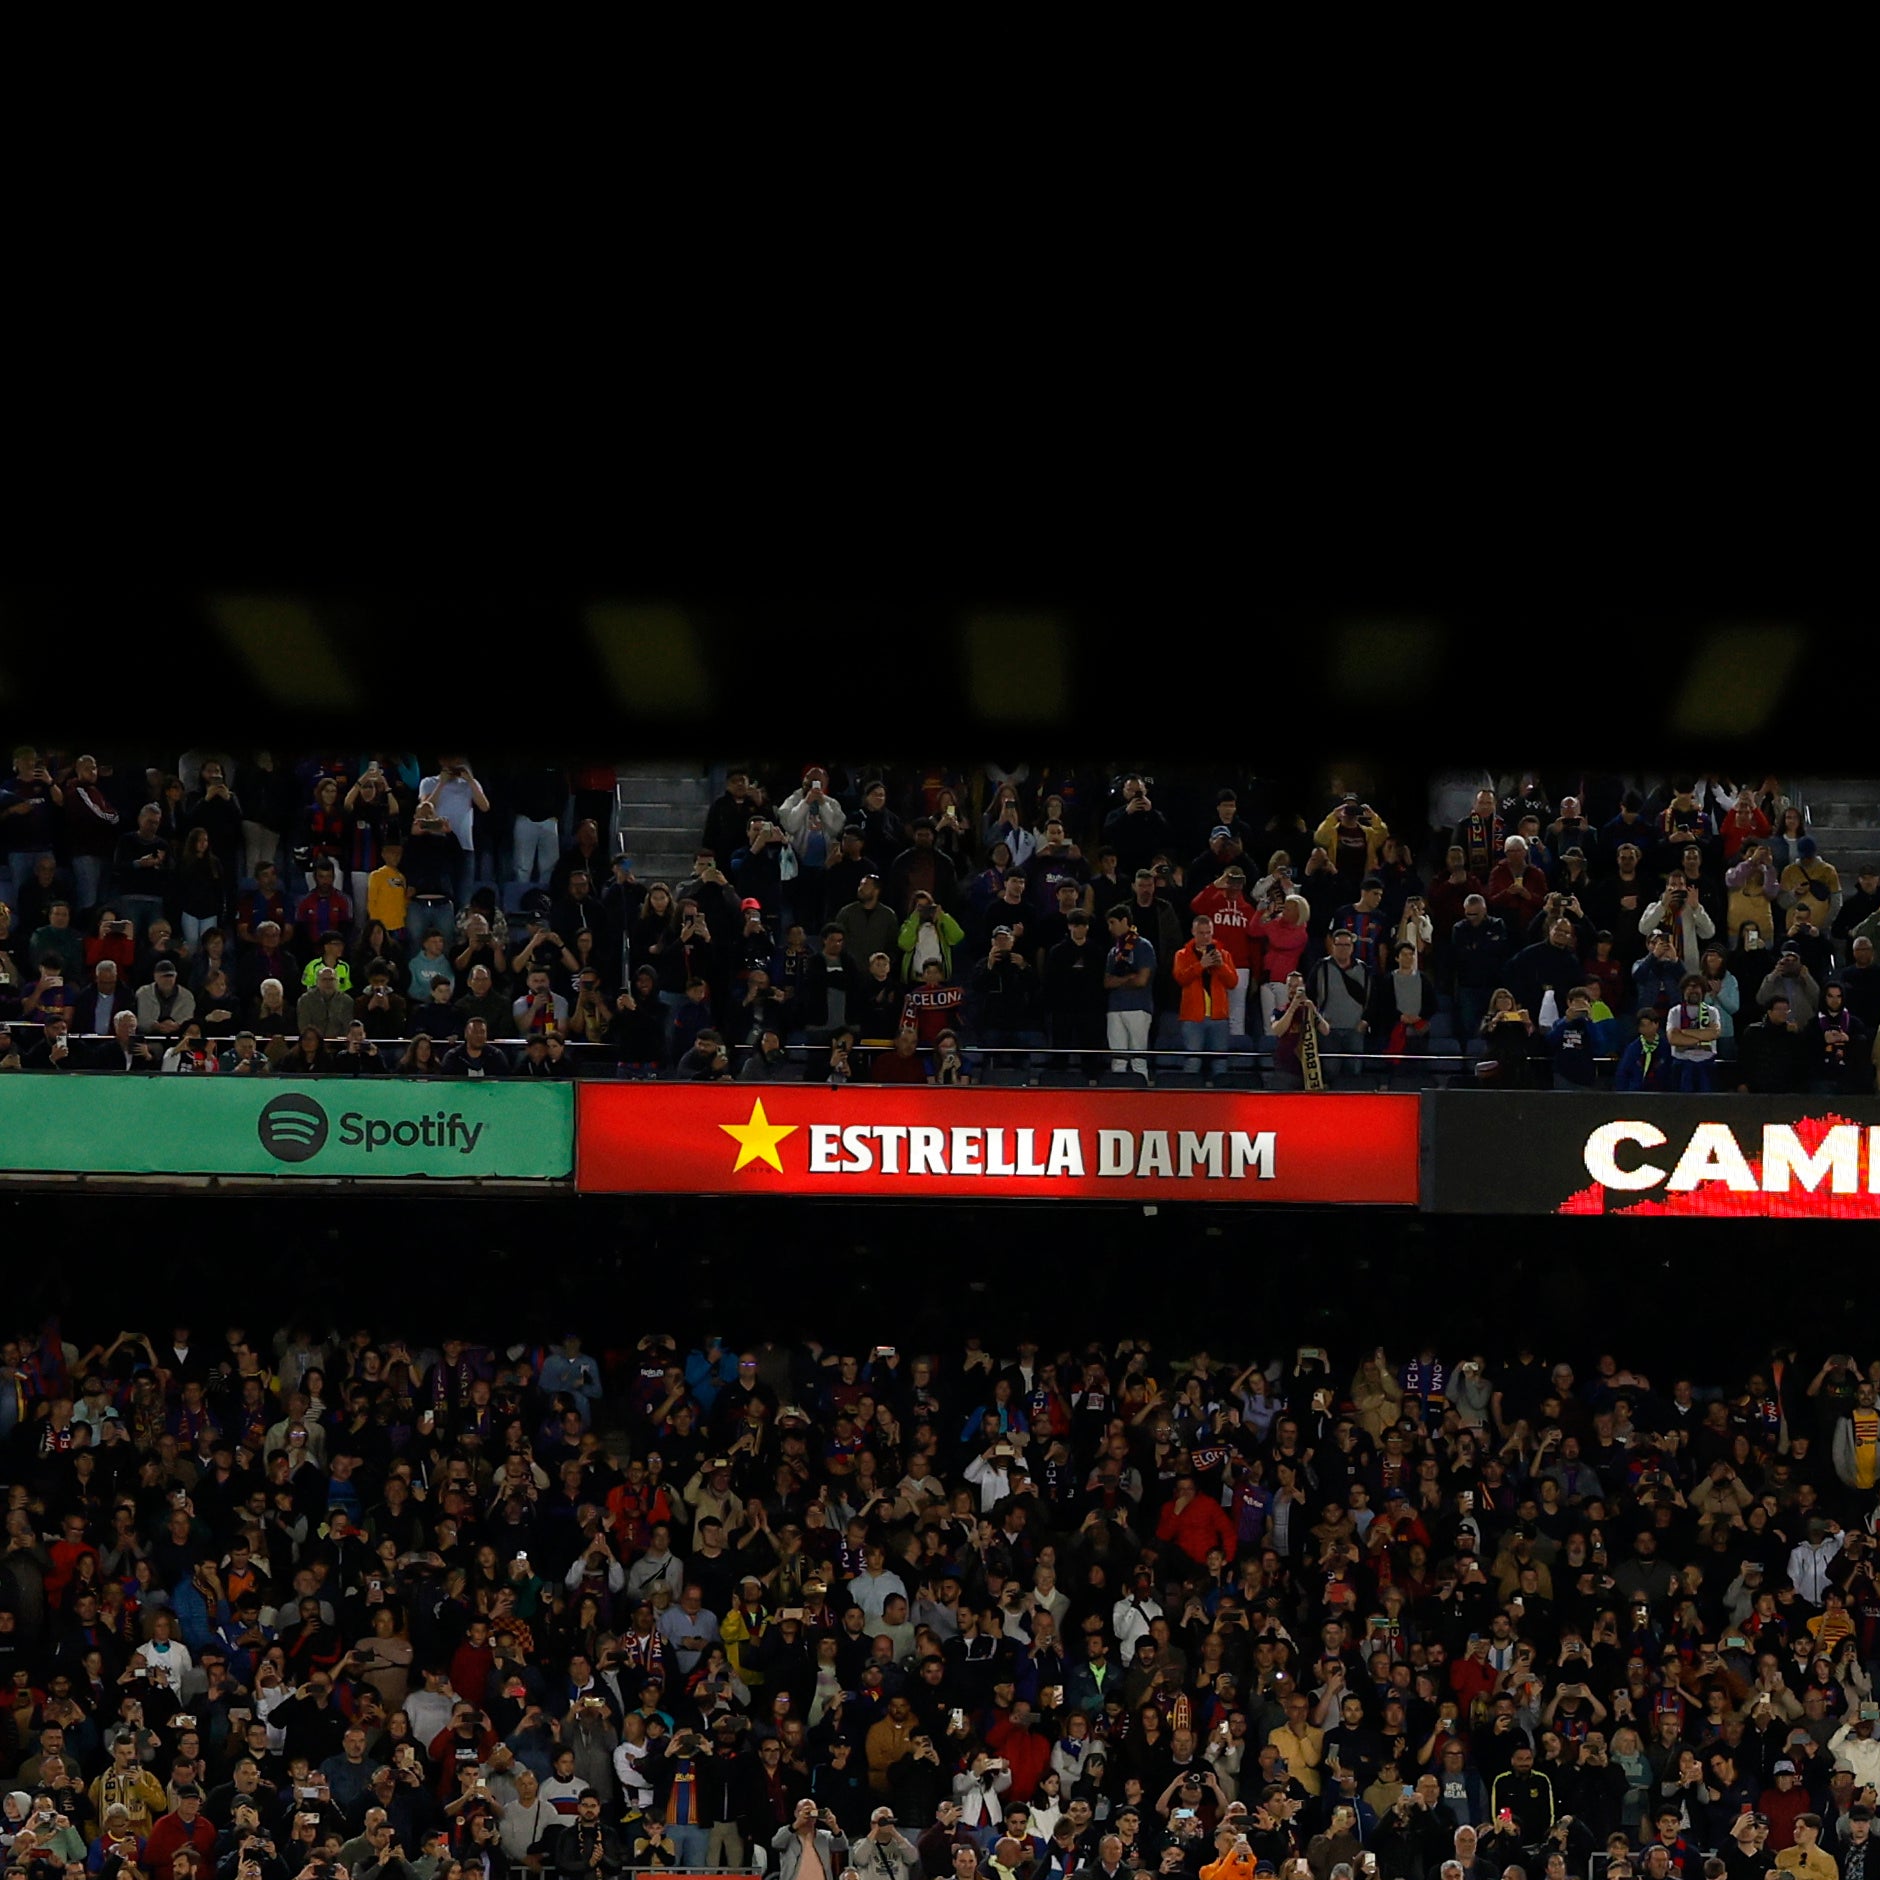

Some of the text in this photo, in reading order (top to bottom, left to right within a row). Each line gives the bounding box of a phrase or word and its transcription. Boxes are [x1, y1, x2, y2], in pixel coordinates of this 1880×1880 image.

[340, 1111, 483, 1153] Spotify
[809, 1123, 1277, 1180] ESTRELLA DAMM
